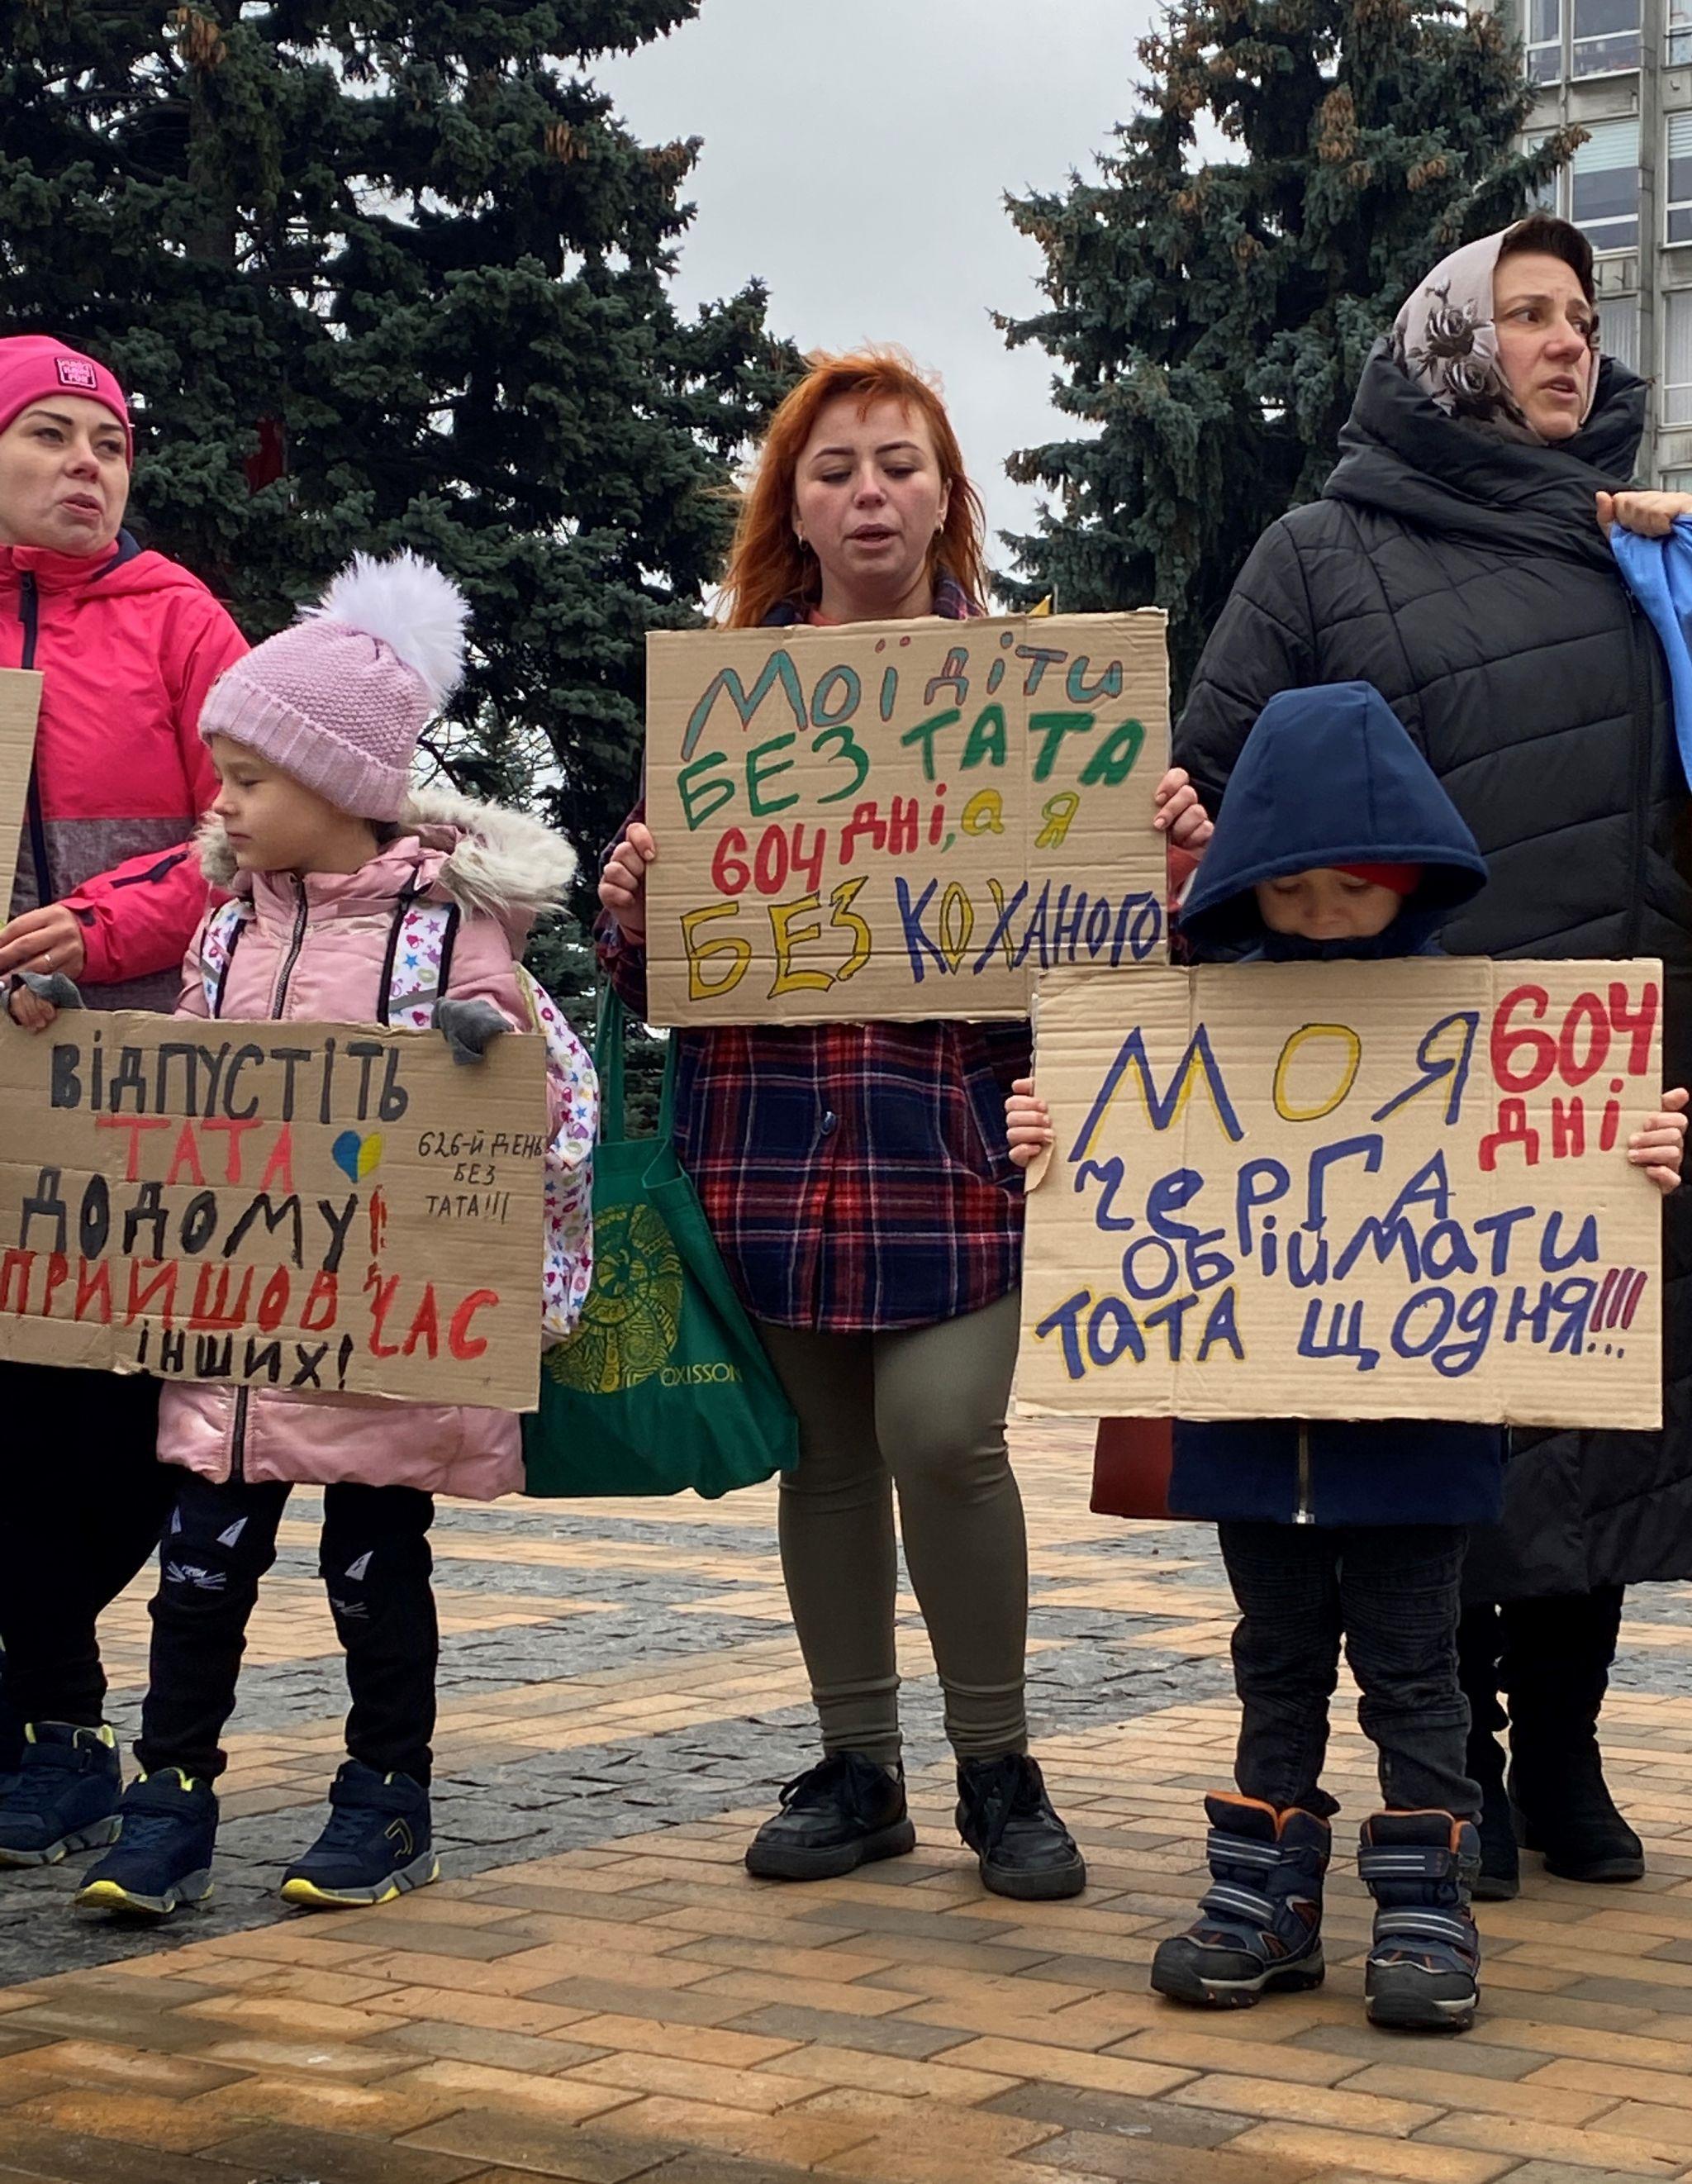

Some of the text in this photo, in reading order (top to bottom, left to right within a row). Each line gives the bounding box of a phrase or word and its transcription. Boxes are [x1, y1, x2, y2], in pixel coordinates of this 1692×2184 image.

[677, 702, 1147, 831] БЕЗ ТАТА
[711, 822, 827, 897] 604
[680, 875, 1162, 1002] БЕЗ КОХАНОГО
[1067, 1011, 1480, 1163] МОЯ
[1489, 981, 1659, 1093] 604
[95, 1116, 295, 1194] ТАТА
[453, 1162, 497, 1186] БЕЗ
[491, 1133, 543, 1159] ДЕНЬ
[0, 1248, 500, 1361] ПРИЙШОВ ЧАС
